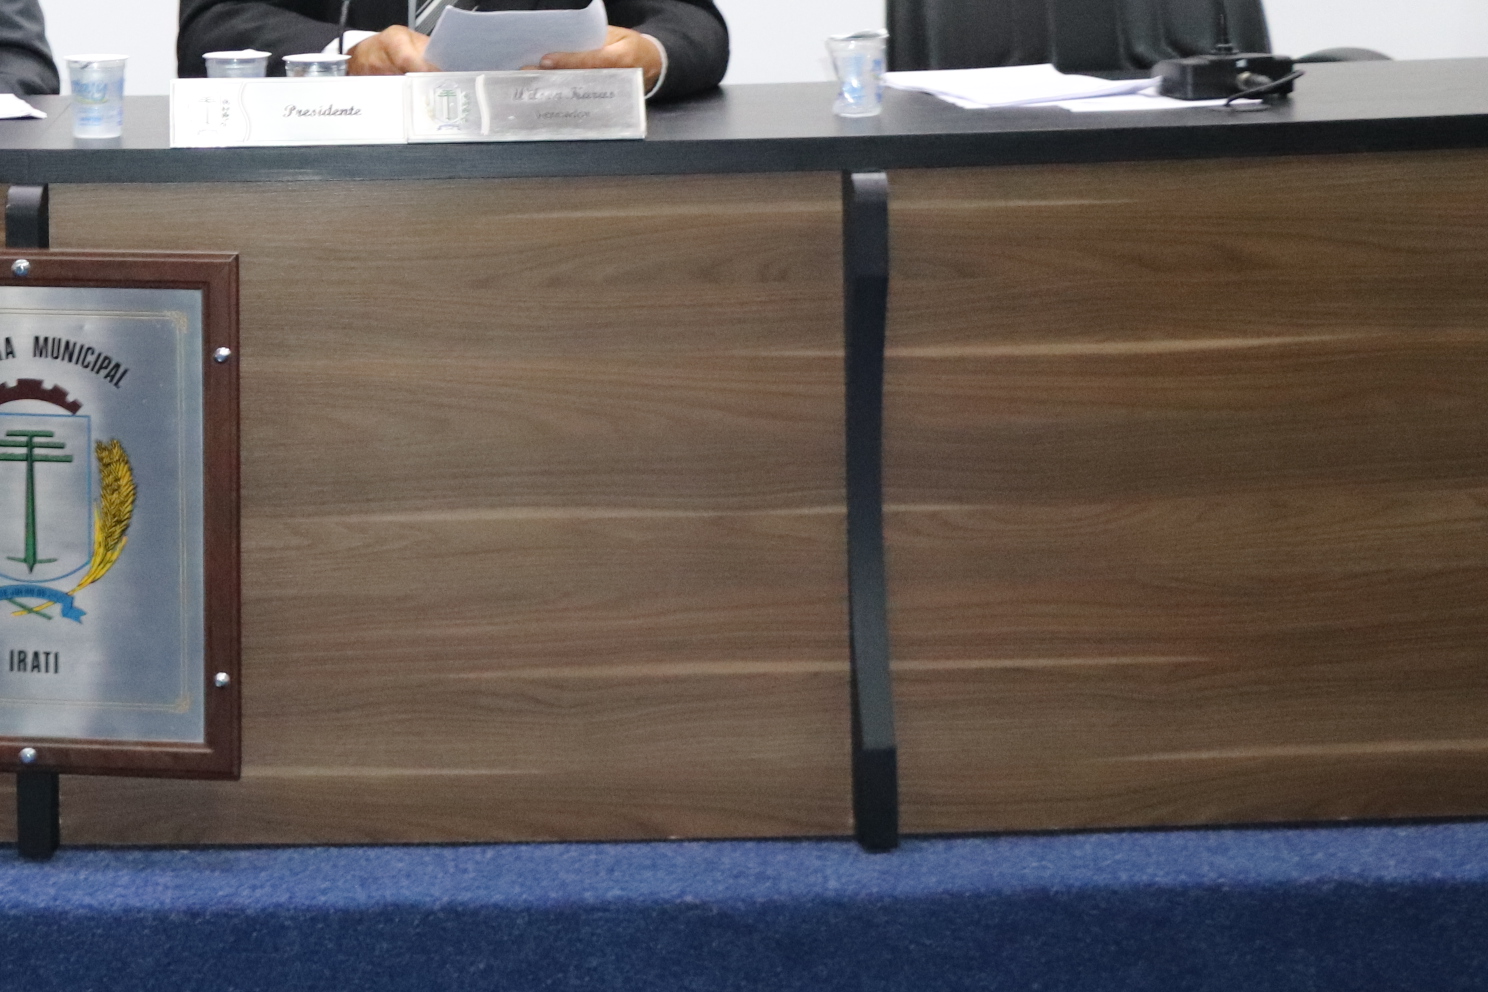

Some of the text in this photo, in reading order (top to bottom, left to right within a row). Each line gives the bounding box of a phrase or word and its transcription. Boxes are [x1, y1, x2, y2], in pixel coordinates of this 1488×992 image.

[281, 103, 363, 118] Presidente
[33, 335, 131, 389] MUNICIPAL
[9, 649, 59, 674] IRATI
